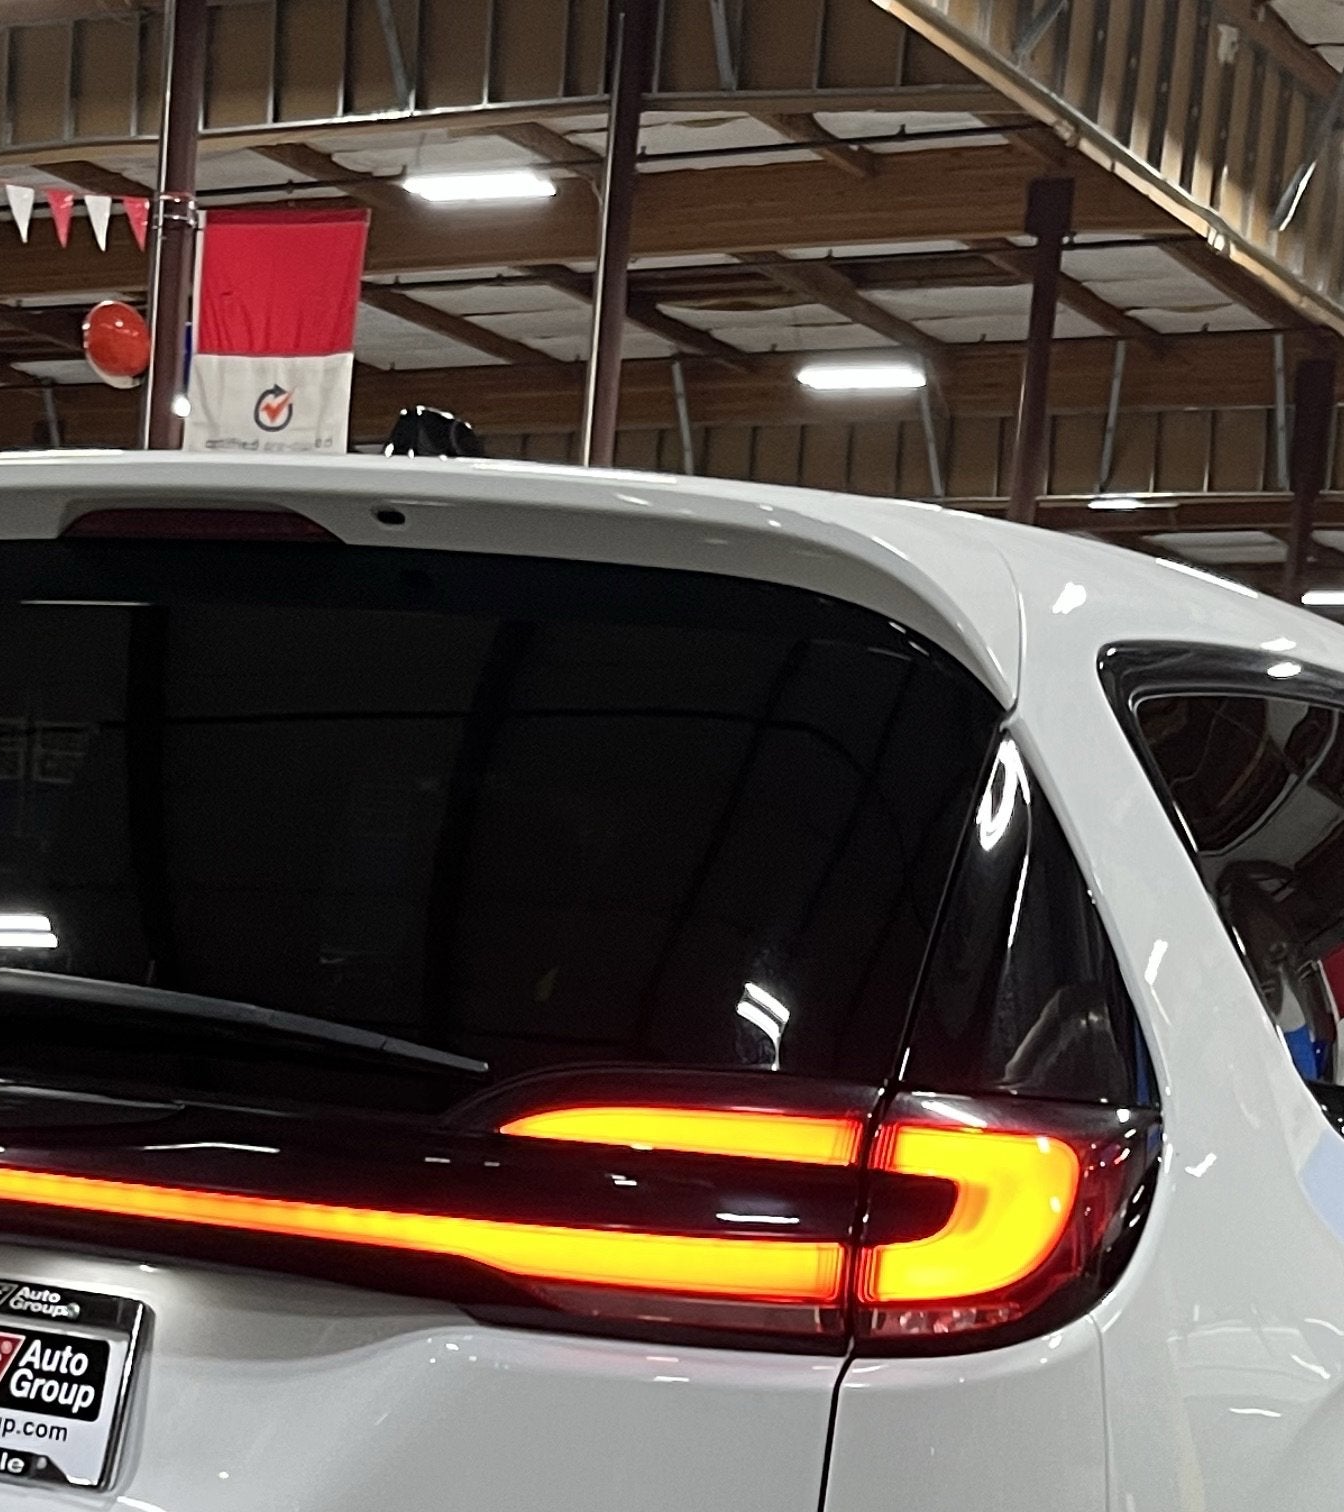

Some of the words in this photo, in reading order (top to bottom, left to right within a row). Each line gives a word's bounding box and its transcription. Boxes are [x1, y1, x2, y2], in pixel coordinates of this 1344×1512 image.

[8, 1296, 70, 1318] Group
[17, 1286, 62, 1303] Auto
[19, 1339, 89, 1376] Auto
[9, 1369, 96, 1414] Group
